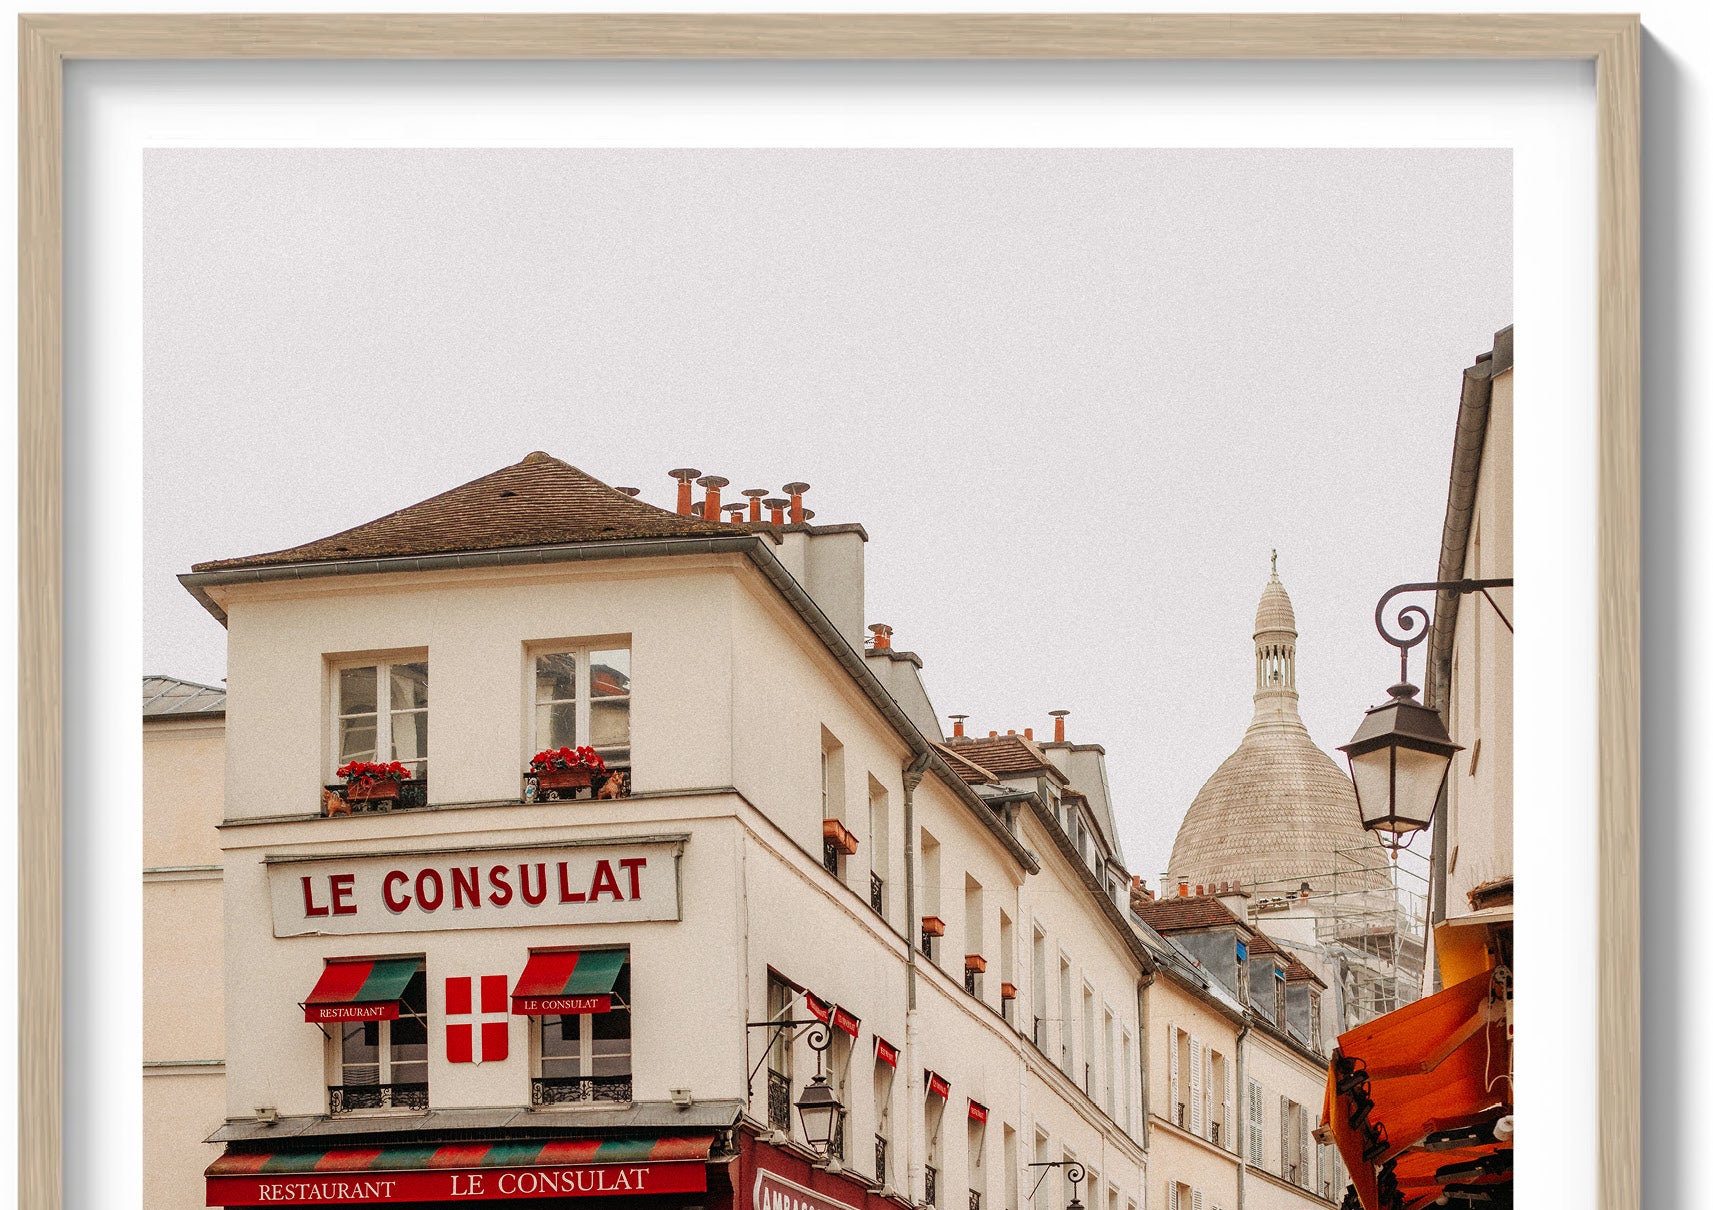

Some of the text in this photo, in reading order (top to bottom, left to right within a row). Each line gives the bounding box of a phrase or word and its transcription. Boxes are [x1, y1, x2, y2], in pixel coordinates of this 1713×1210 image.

[300, 857, 648, 918] LE CONSULAT
[318, 1006, 386, 1020] RESTAURANT
[523, 998, 600, 1011] LE CONSULAT
[258, 1168, 650, 1201] RESTAURANT LE CONSULAT
